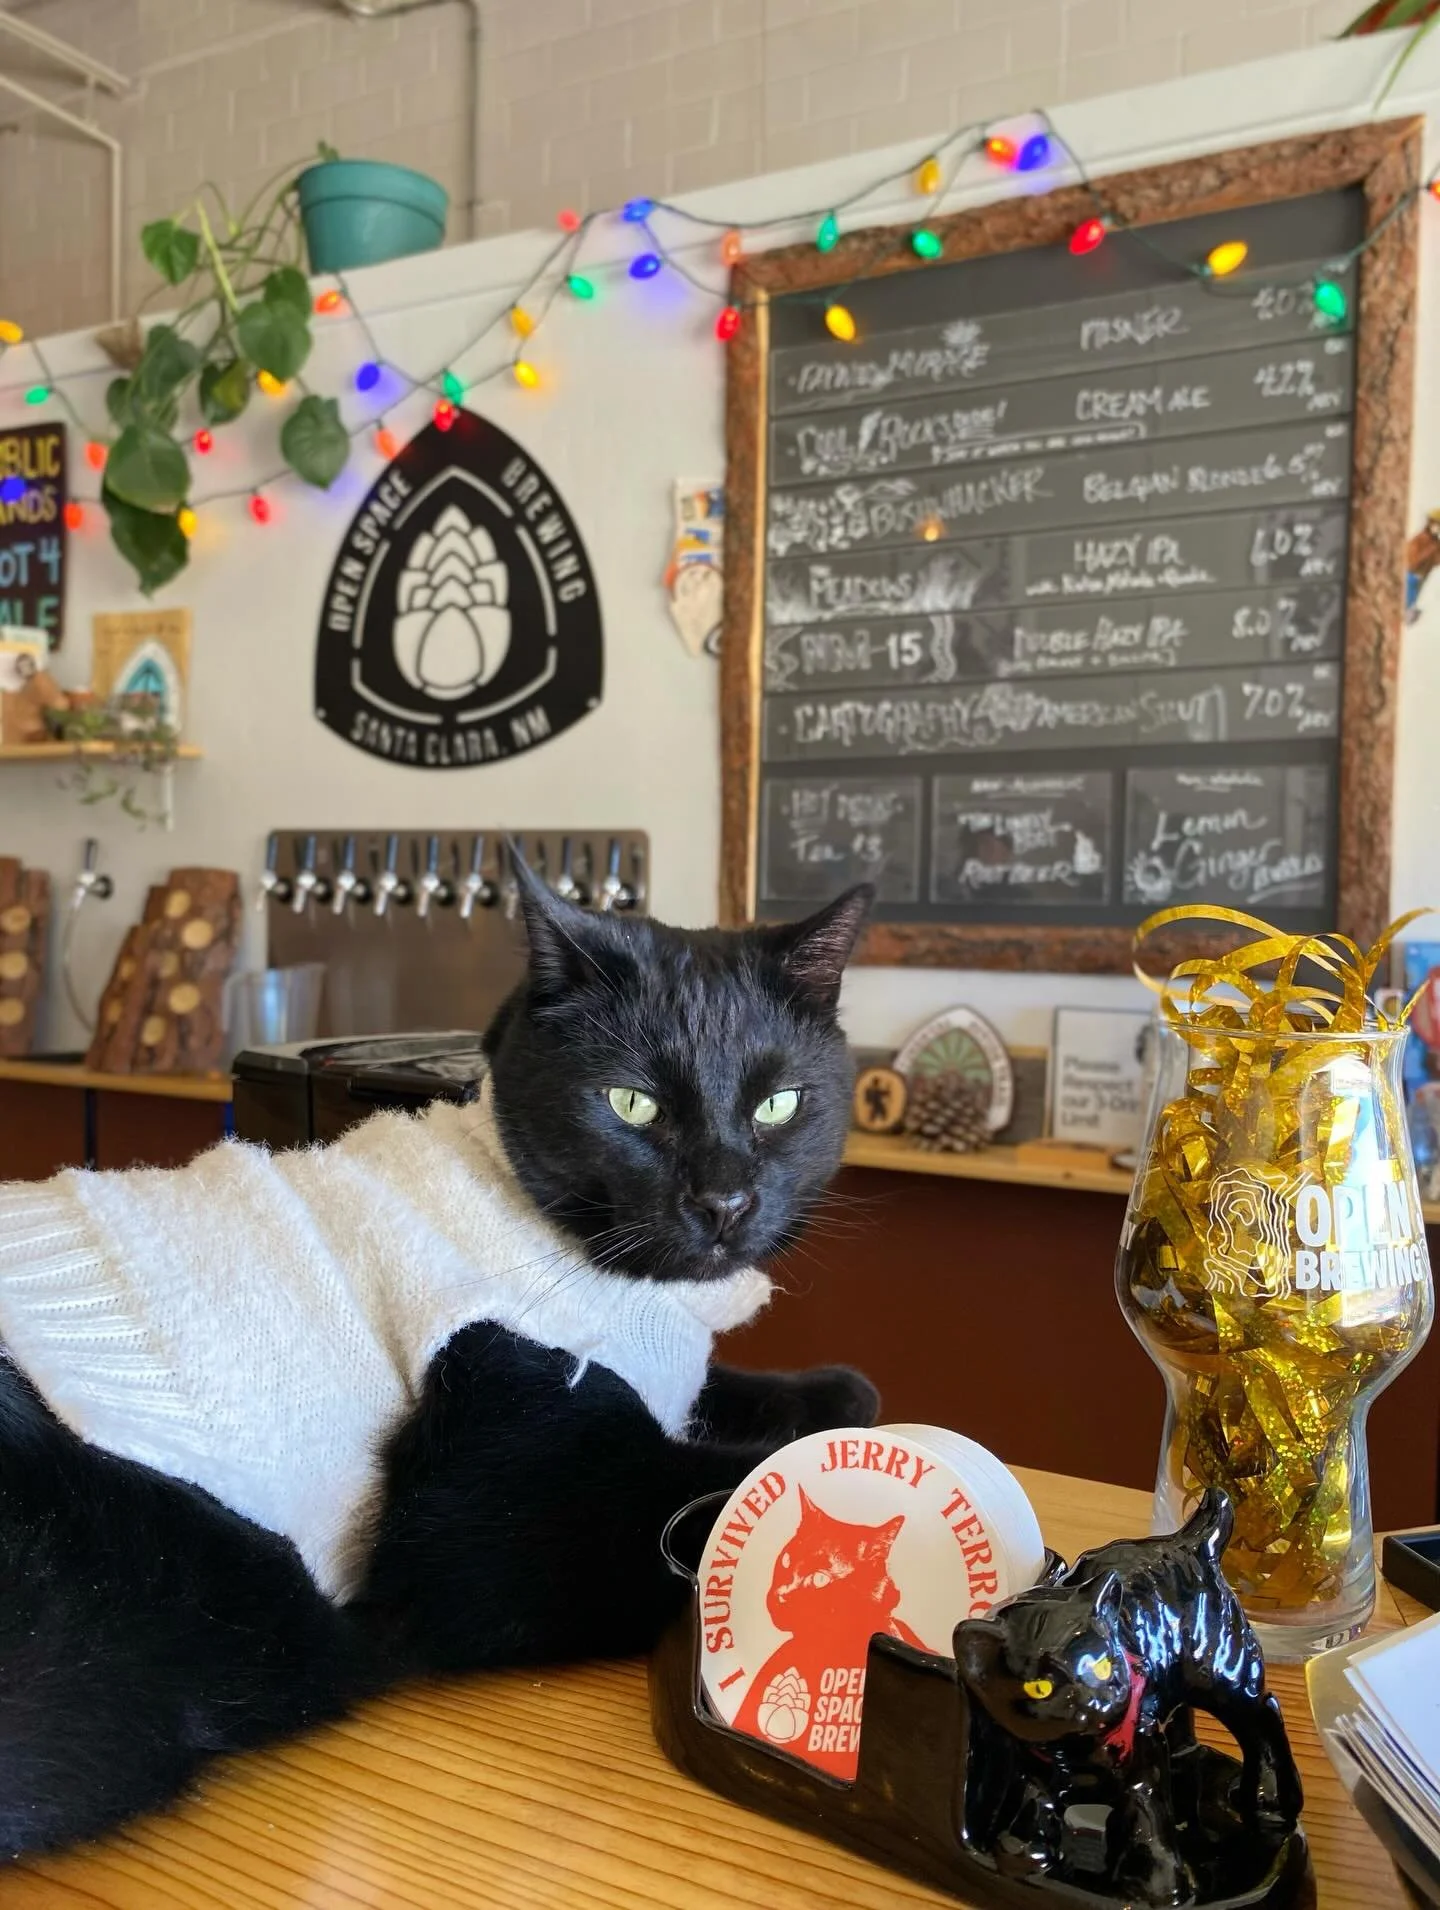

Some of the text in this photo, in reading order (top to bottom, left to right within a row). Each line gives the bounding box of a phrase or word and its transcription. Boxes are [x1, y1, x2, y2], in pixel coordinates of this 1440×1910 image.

[1076, 386, 1163, 420] CREAM
[1168, 386, 1211, 411] ALE
[1084, 465, 1180, 502] BELGIAN
[38, 536, 61, 586] 4
[328, 457, 587, 632] OPEN SPACE BREWING
[1074, 533, 1143, 573] HAZY
[1147, 534, 1184, 565] IPA
[1092, 615, 1145, 652] HAZY
[1147, 615, 1190, 648] IPA
[352, 711, 417, 760] SANTA
[1152, 808, 1267, 851] Lemon
[1174, 837, 1283, 890] Ginger
[1296, 1181, 1413, 1247] OPEN
[1296, 1241, 1423, 1290] BREWING
[820, 1439, 936, 1488] JERRY
[704, 1471, 787, 1653] SURVIVED
[718, 1667, 746, 1692] I
